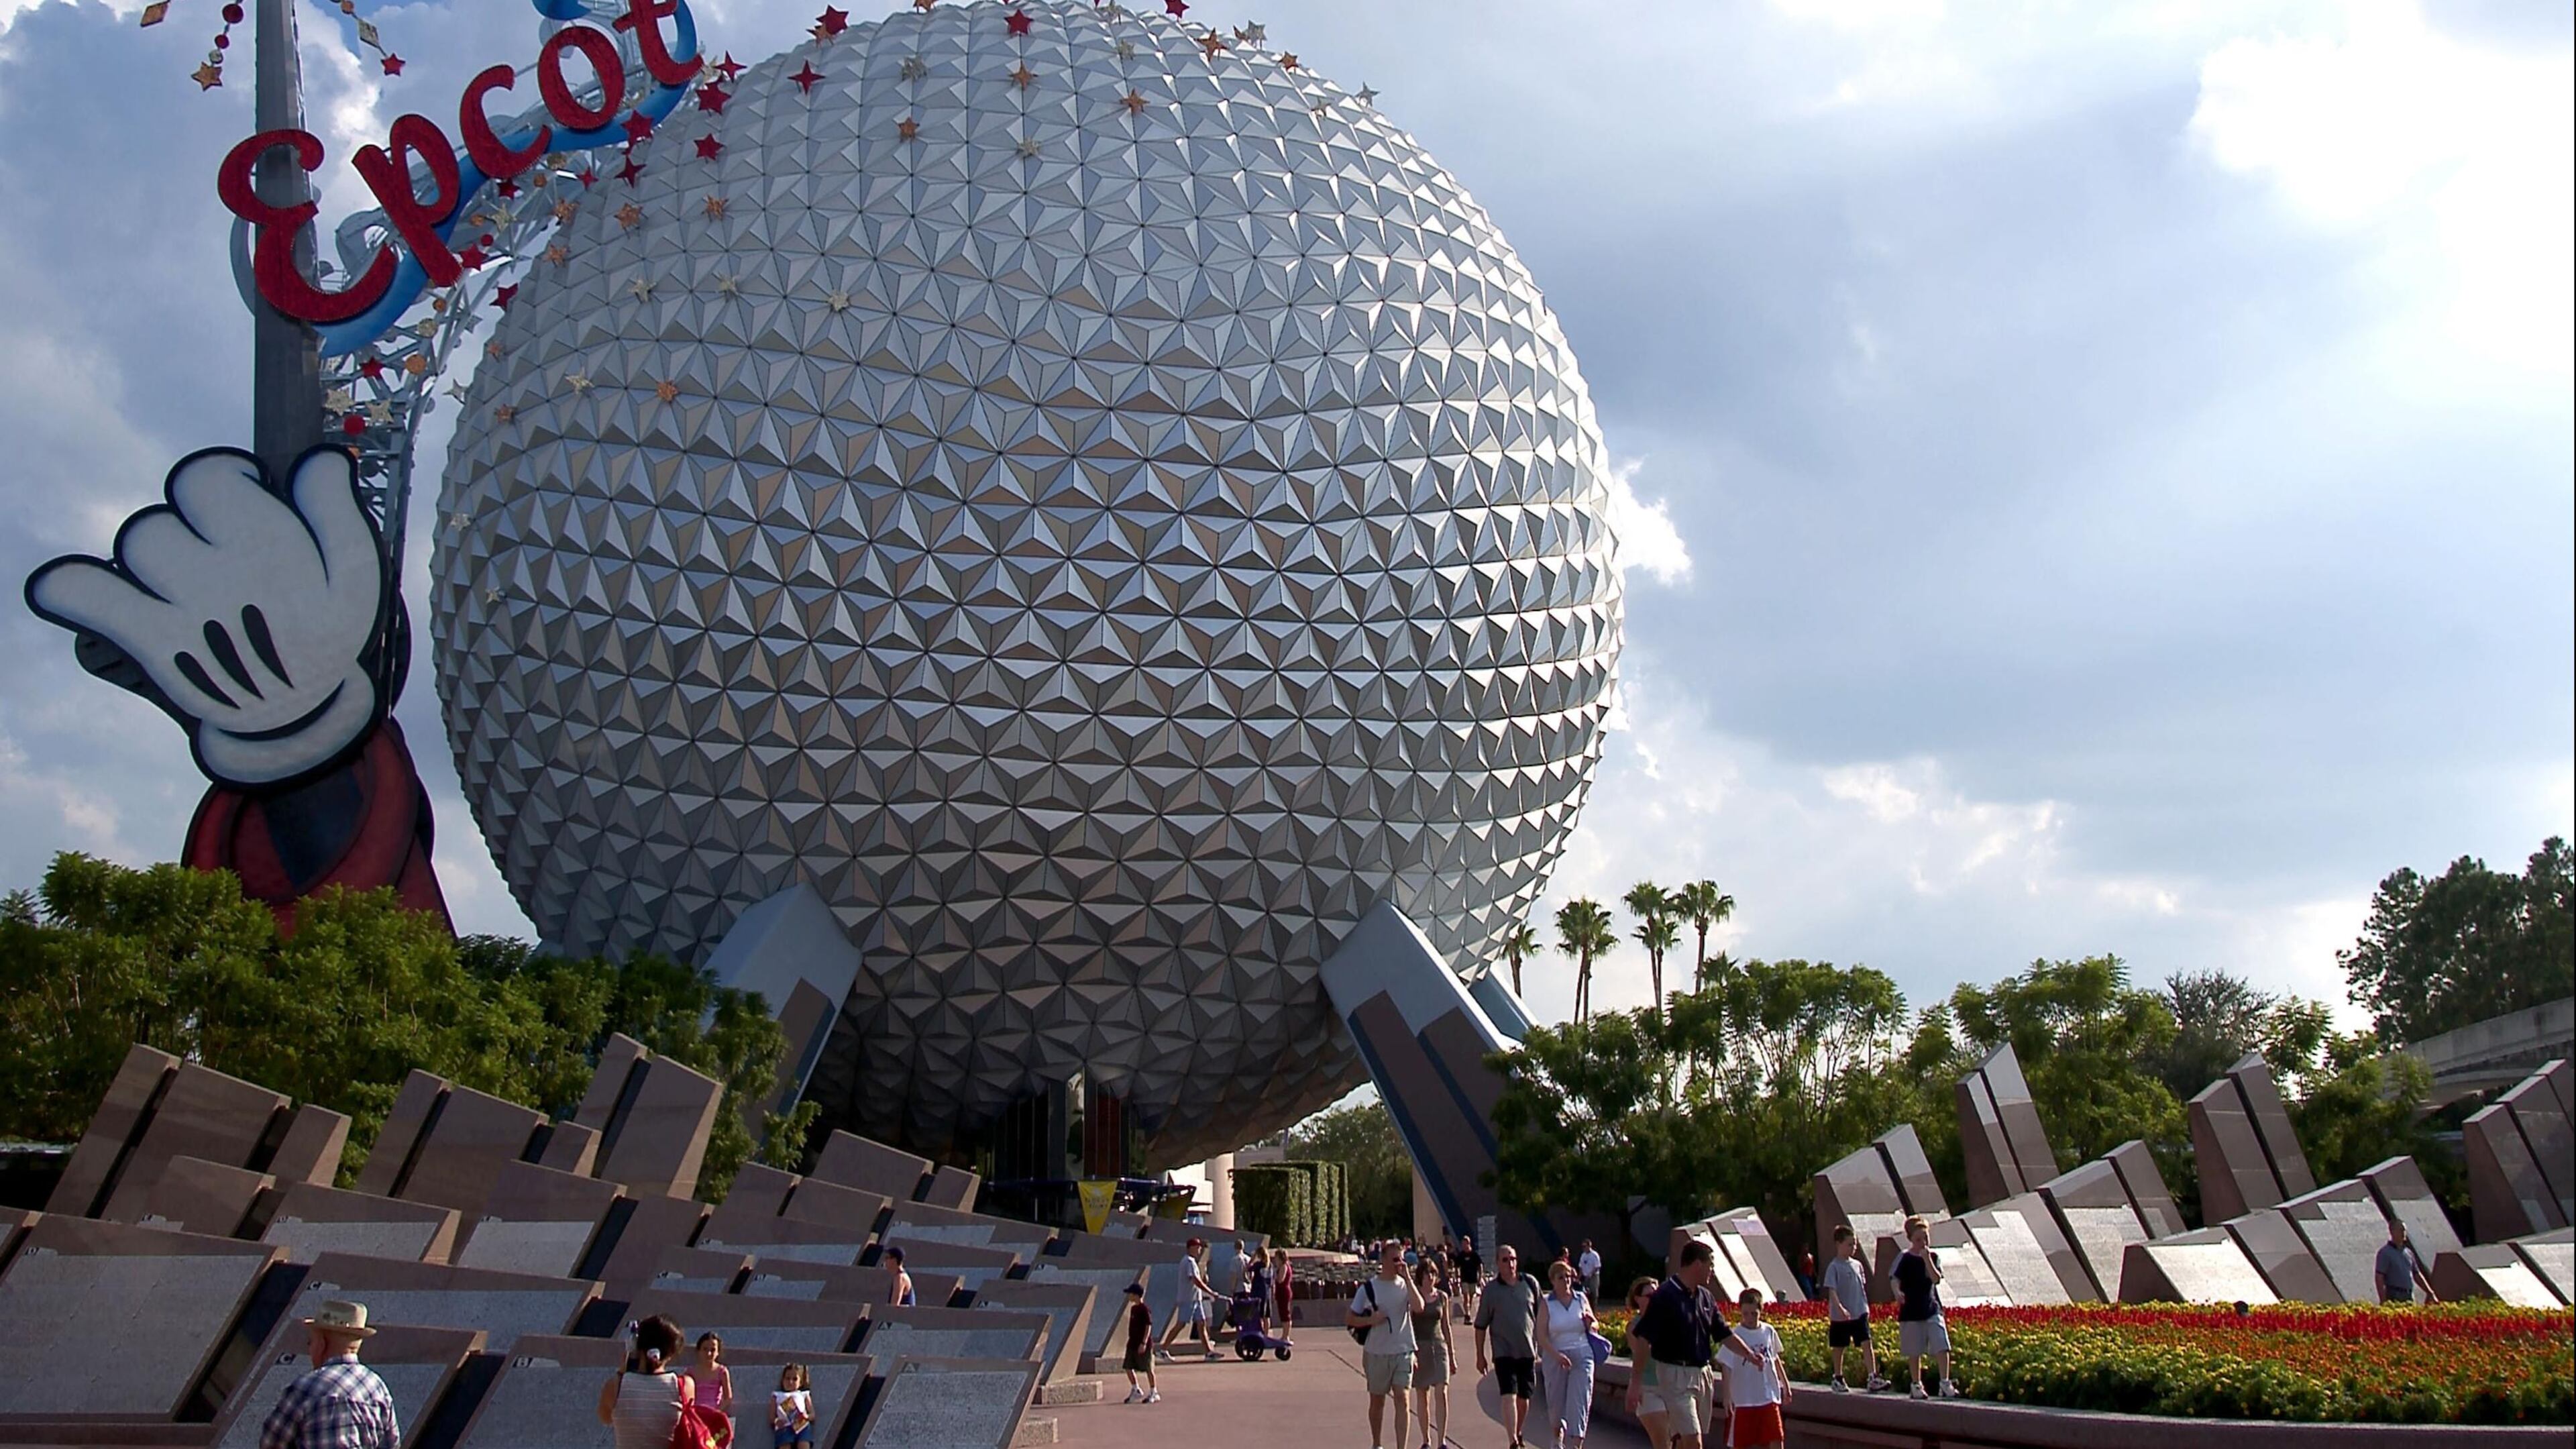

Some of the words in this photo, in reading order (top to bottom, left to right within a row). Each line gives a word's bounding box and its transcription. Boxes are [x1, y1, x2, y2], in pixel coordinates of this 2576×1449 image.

[218, 0, 704, 323] Epcot
[310, 1281, 319, 1289] C
[880, 1321, 889, 1330] A
[280, 1353, 292, 1364] C
[517, 1357, 528, 1367] B
[904, 1363, 916, 1373] A
